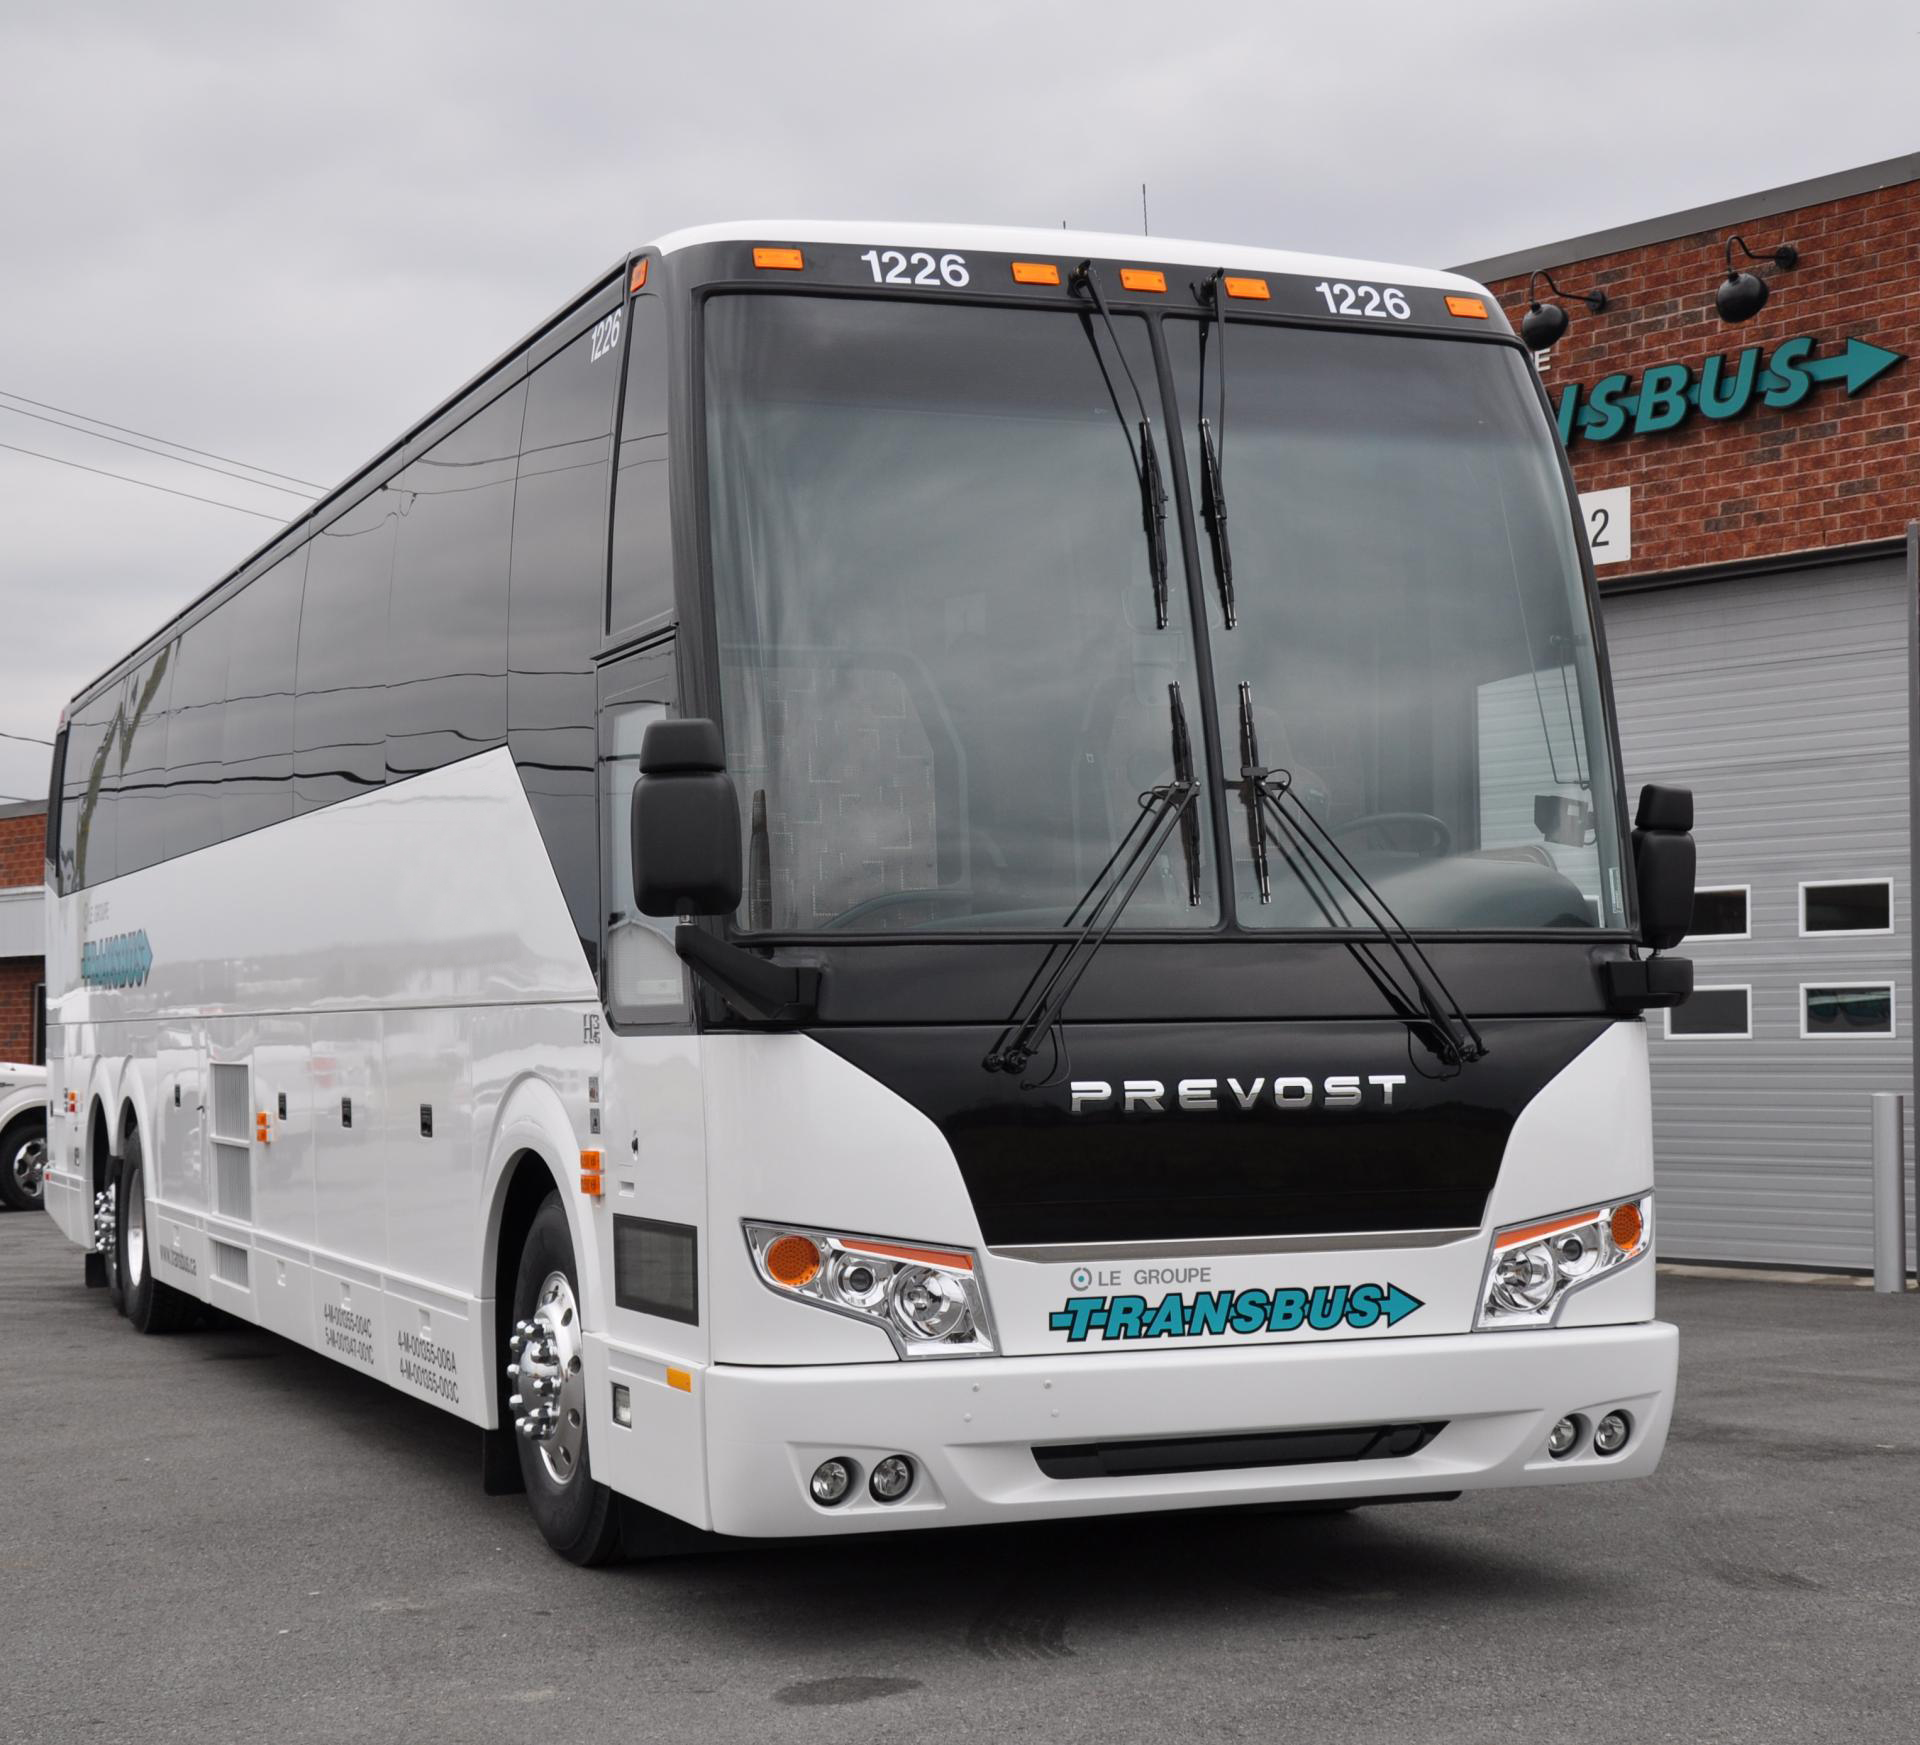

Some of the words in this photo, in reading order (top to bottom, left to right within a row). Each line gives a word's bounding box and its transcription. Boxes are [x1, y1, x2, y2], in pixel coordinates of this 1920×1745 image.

[861, 250, 970, 287] 1226
[1315, 282, 1411, 319] 1226
[590, 307, 622, 364] 1226
[1070, 1075, 1406, 1112] PREVOST
[1097, 1271, 1122, 1286] LE
[1133, 1267, 1212, 1285] GROUPE
[1064, 1281, 1390, 1342] TRANSBUS
